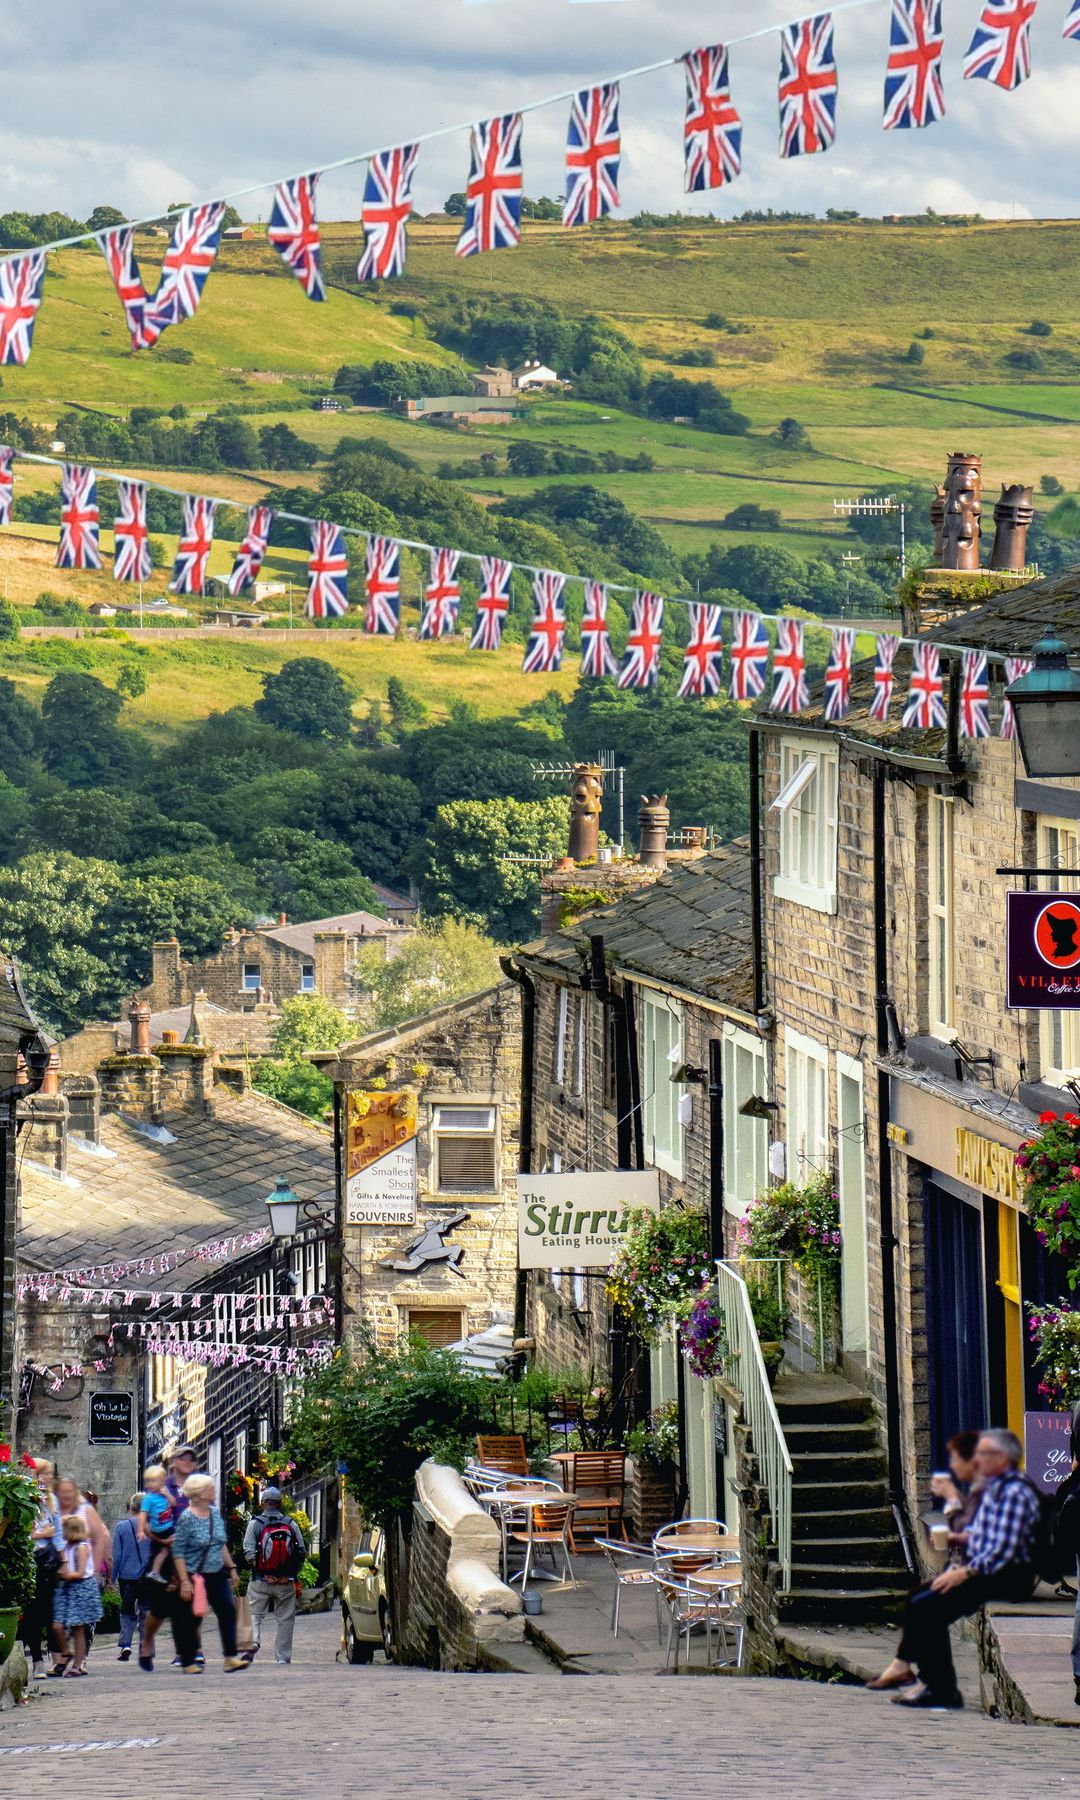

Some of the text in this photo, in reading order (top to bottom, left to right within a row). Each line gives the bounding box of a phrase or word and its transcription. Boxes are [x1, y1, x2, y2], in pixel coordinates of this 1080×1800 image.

[395, 1155, 414, 1164] The
[371, 1166, 414, 1176] Smallest
[388, 1179, 414, 1190] Shop
[382, 1193, 414, 1201] Novelties
[522, 1192, 546, 1203] The
[349, 1211, 414, 1222] SOUVENIRS
[524, 1200, 630, 1237] Stirru
[542, 1235, 625, 1249] Eating House
[94, 1402, 106, 1411] Oh
[95, 1413, 128, 1422] Vintage
